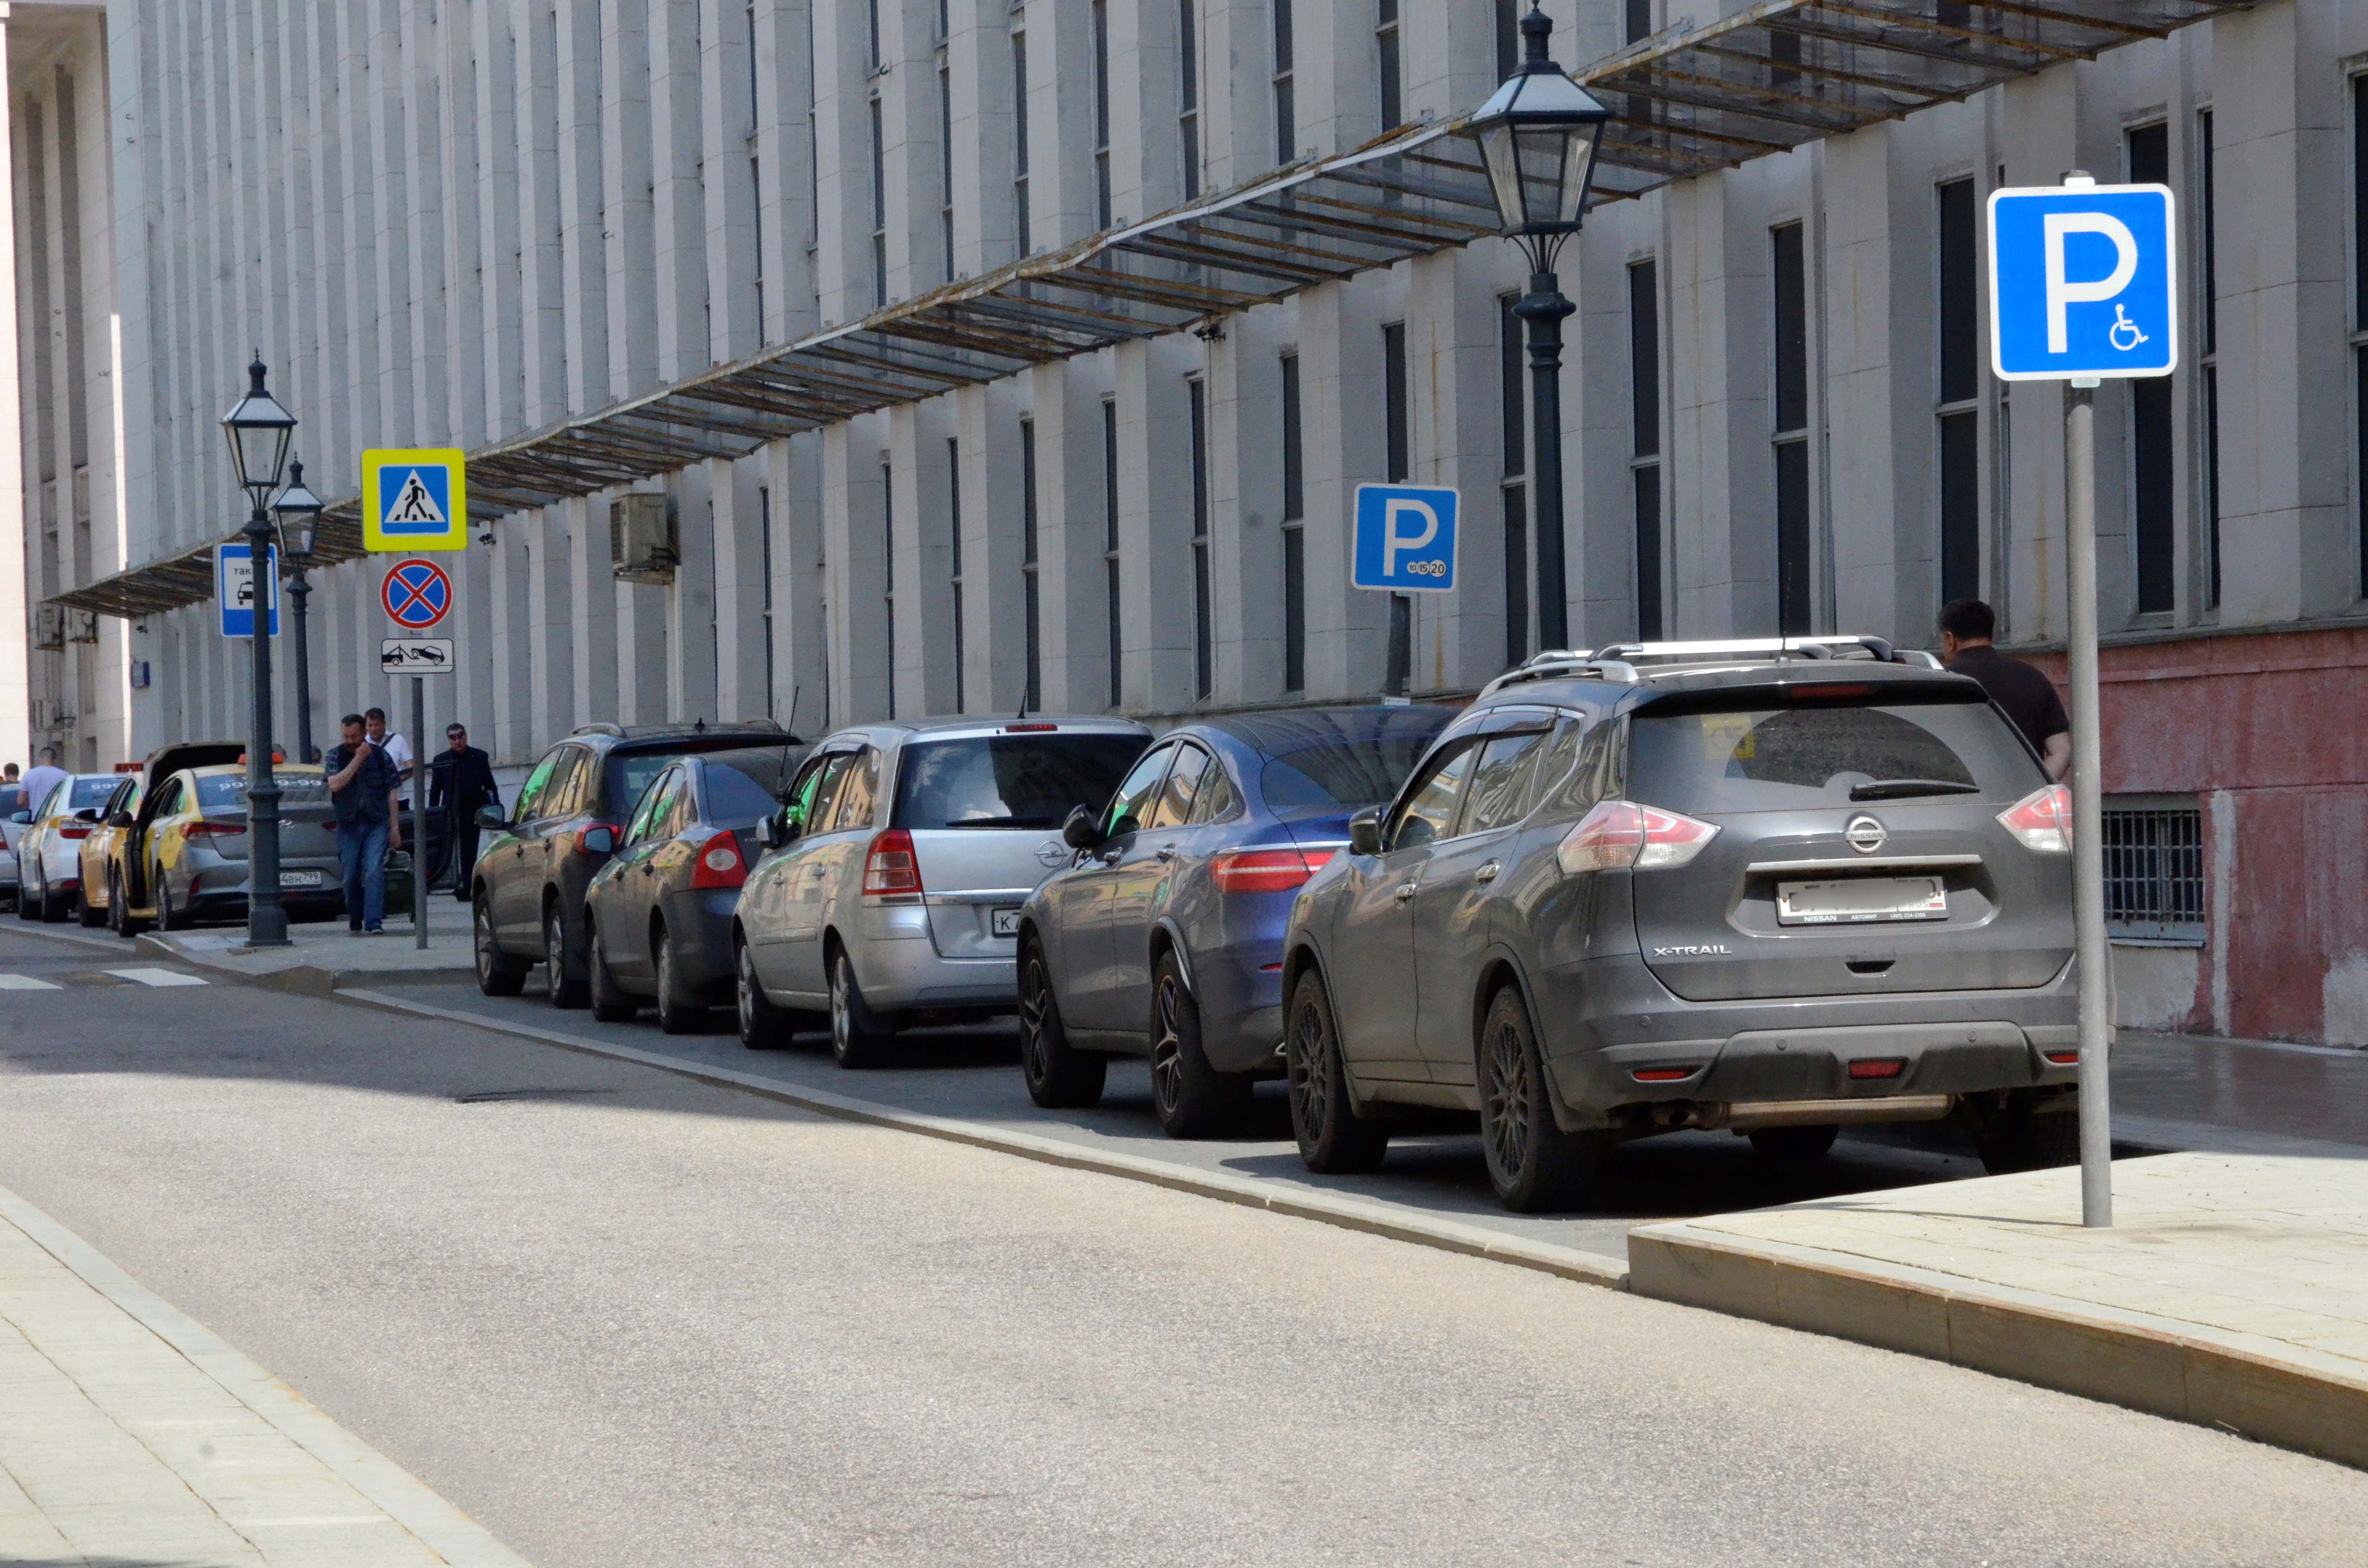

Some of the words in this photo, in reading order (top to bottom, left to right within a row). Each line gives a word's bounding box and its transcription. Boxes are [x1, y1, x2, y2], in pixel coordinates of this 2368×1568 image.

[2044, 212, 2138, 354] P
[1383, 498, 1438, 576] P
[1419, 564, 1428, 573] 15
[1431, 564, 1444, 574] 20
[1909, 900, 1929, 908] RUS
[1653, 944, 1733, 958] X-TRAIL
